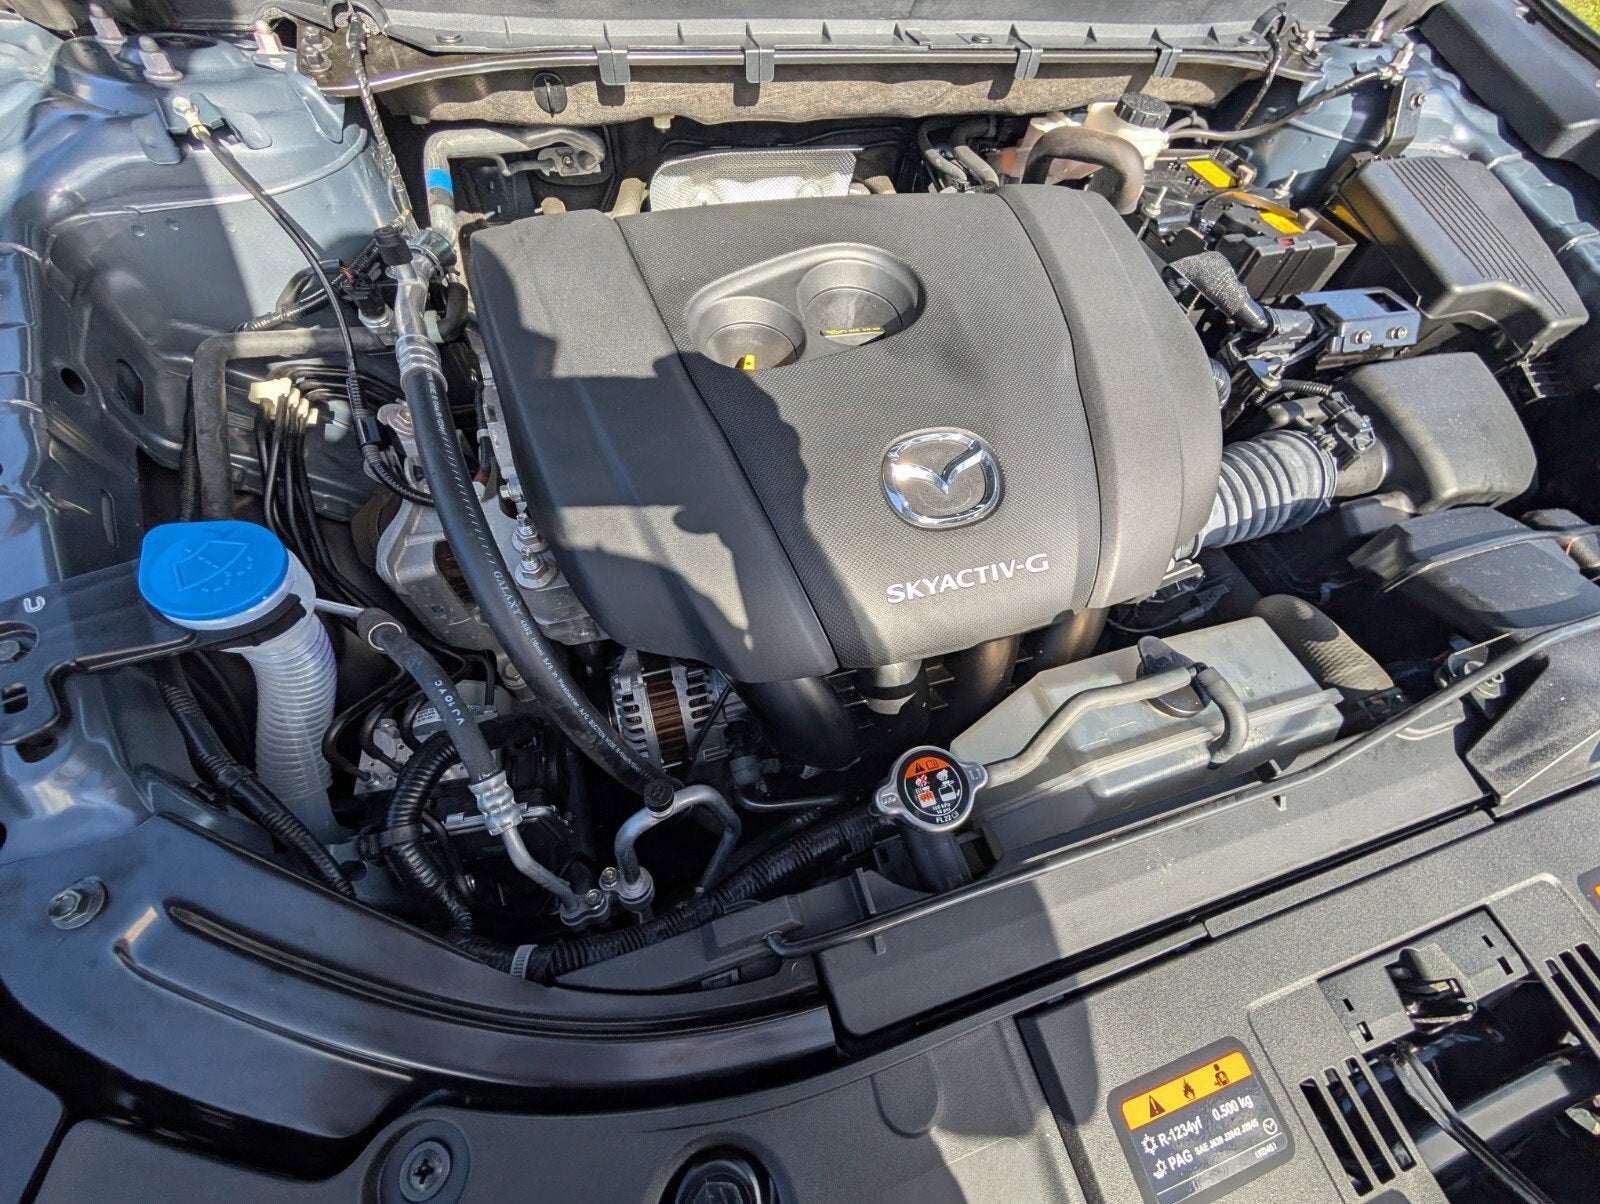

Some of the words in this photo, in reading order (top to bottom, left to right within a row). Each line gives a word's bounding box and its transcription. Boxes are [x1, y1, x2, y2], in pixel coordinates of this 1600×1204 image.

[886, 553, 1050, 604] SKYACTIV-G
[493, 570, 523, 615] GALAXY
[579, 708, 590, 720] A/C
[936, 814, 952, 823] FL22
[1157, 1115, 1203, 1147] R-1234yf
[1211, 1099, 1239, 1121] 0.500
[1237, 1094, 1254, 1109] kg
[1167, 1148, 1194, 1171] PAG
[1194, 1142, 1210, 1156] SAE
